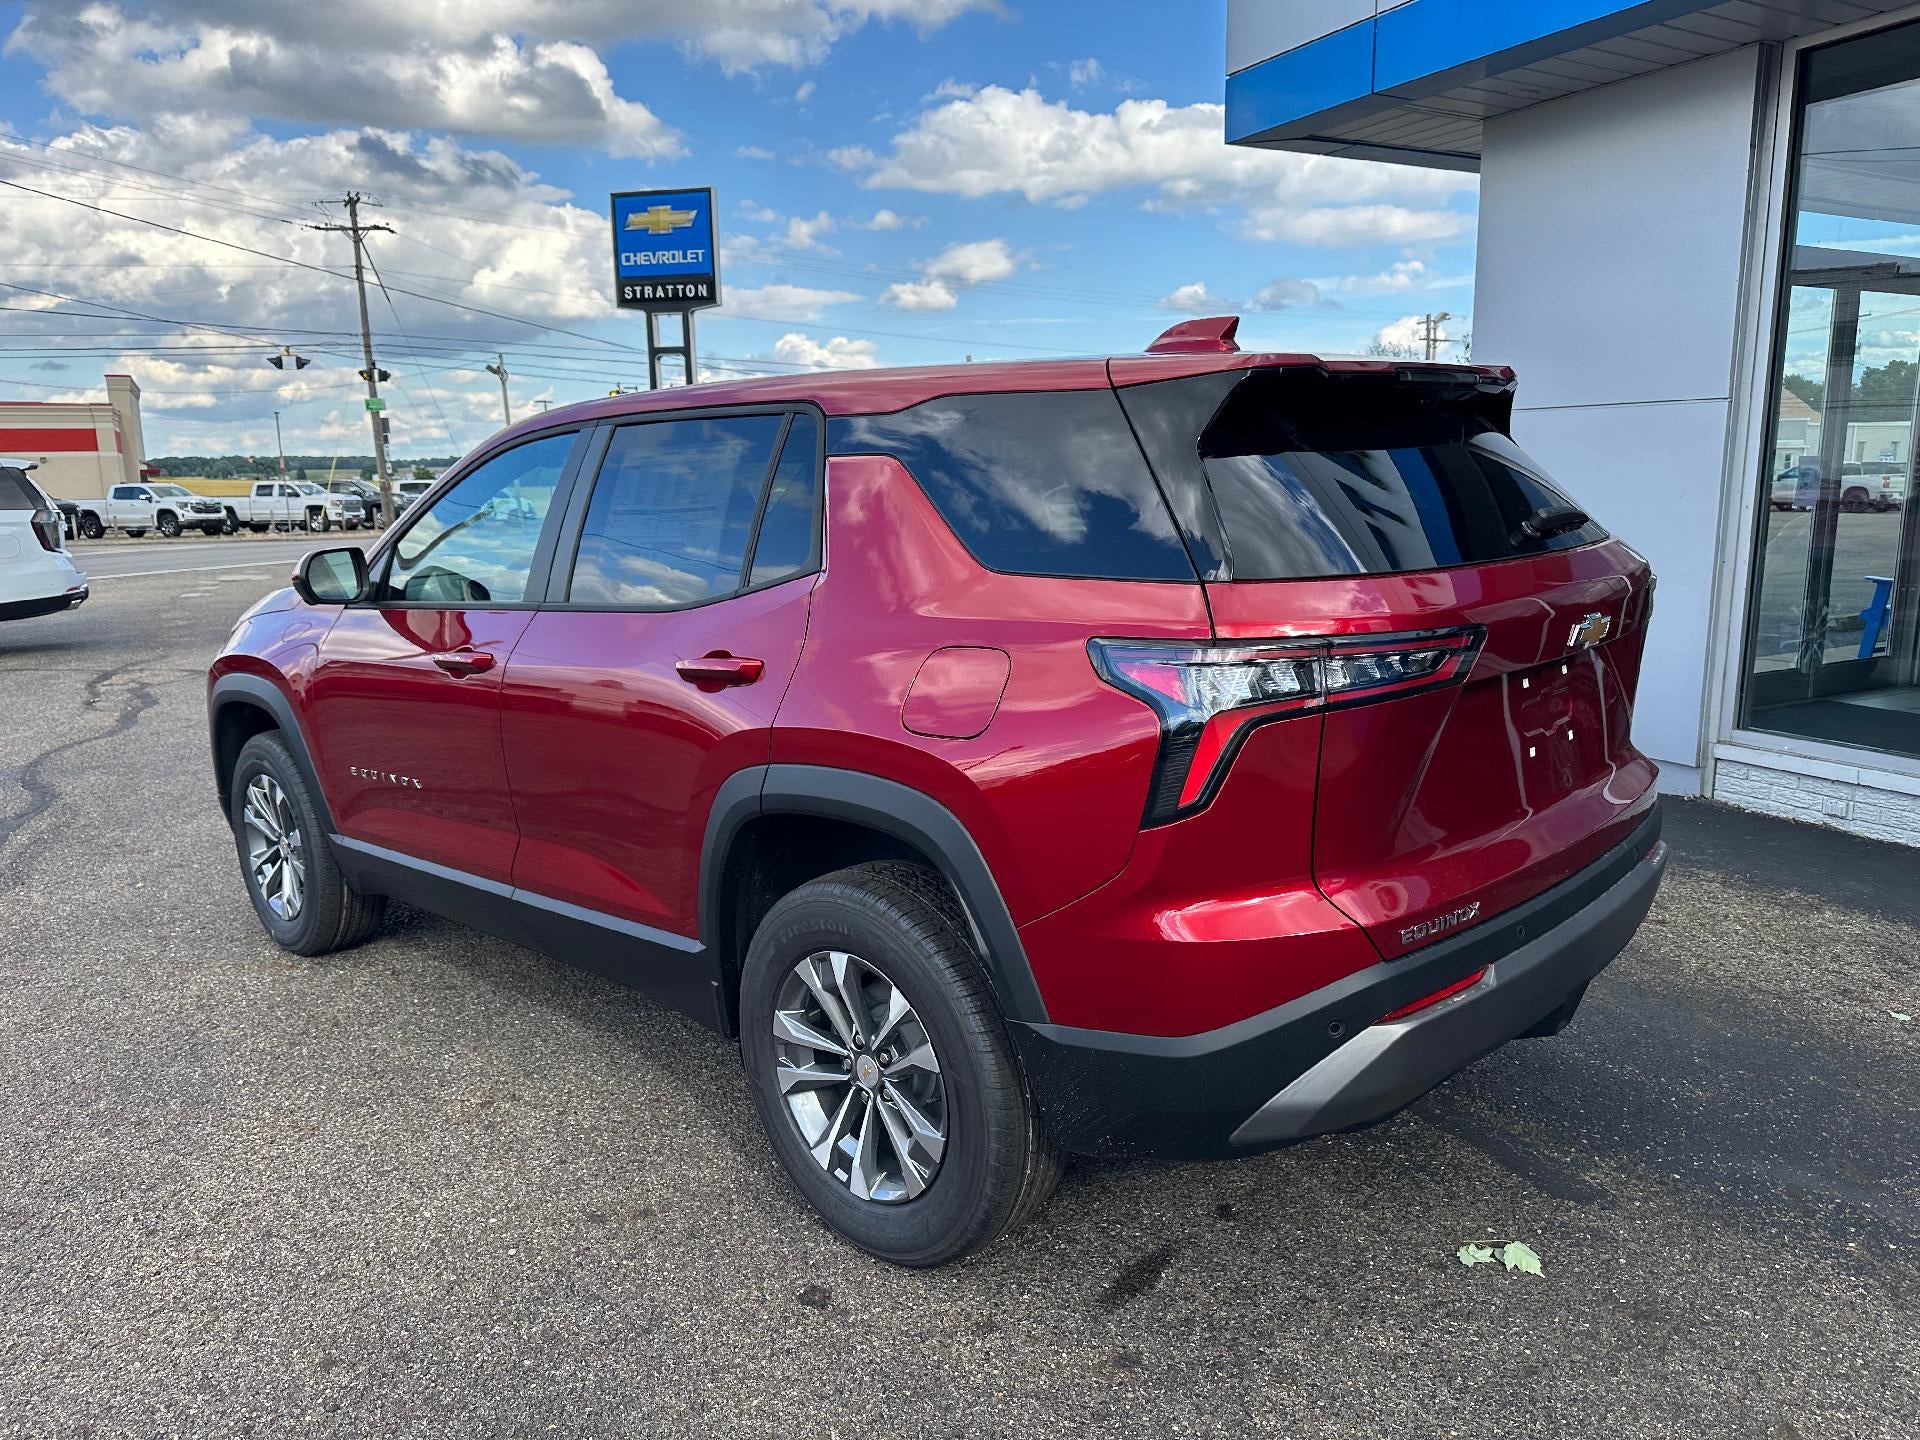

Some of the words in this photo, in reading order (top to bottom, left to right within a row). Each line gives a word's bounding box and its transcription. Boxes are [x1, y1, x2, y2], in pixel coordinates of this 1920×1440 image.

[621, 249, 705, 266] CHEVROLET
[624, 284, 708, 300] STRATTON
[350, 766, 423, 789] EQUINOX
[1399, 901, 1480, 945] EQUINOX
